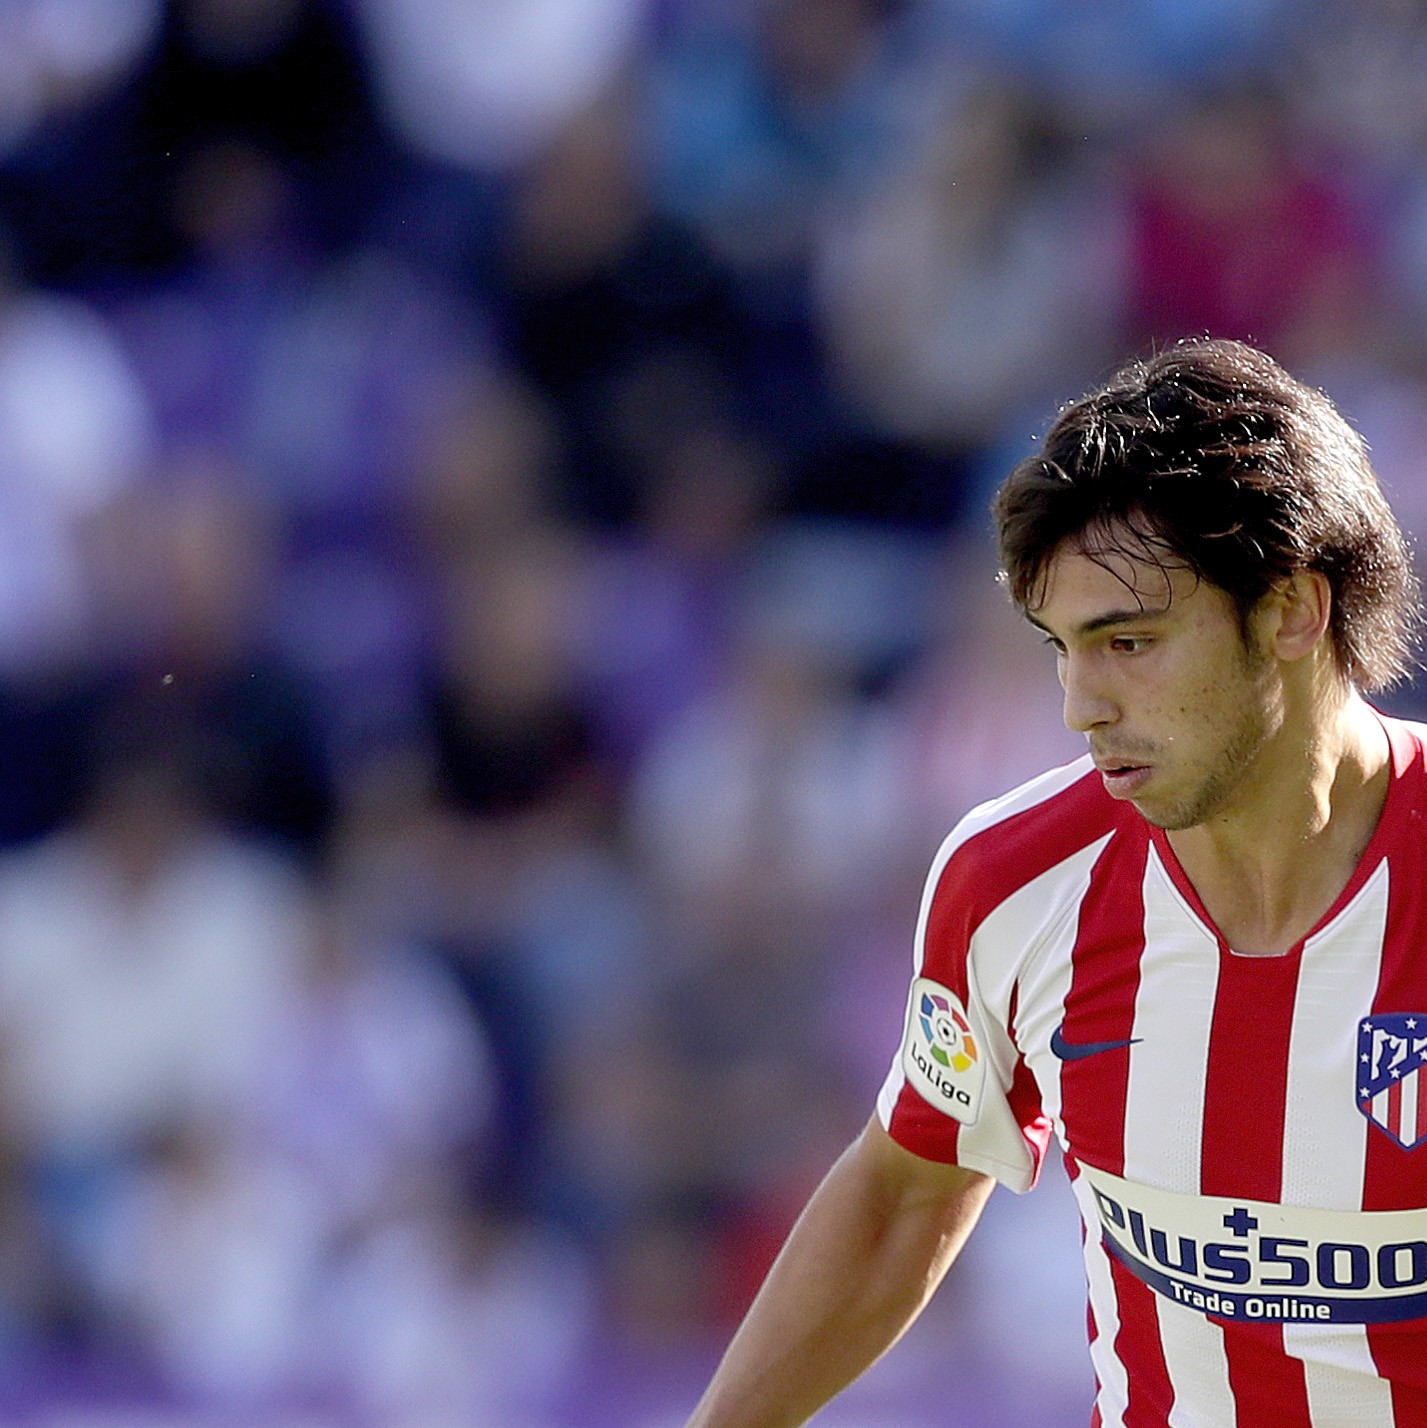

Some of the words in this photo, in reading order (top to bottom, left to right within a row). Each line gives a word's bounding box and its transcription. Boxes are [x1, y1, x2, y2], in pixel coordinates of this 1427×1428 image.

[911, 1040, 971, 1106] LaLiga
[1170, 1280, 1235, 1316] Trade
[1245, 1297, 1331, 1320] Online
